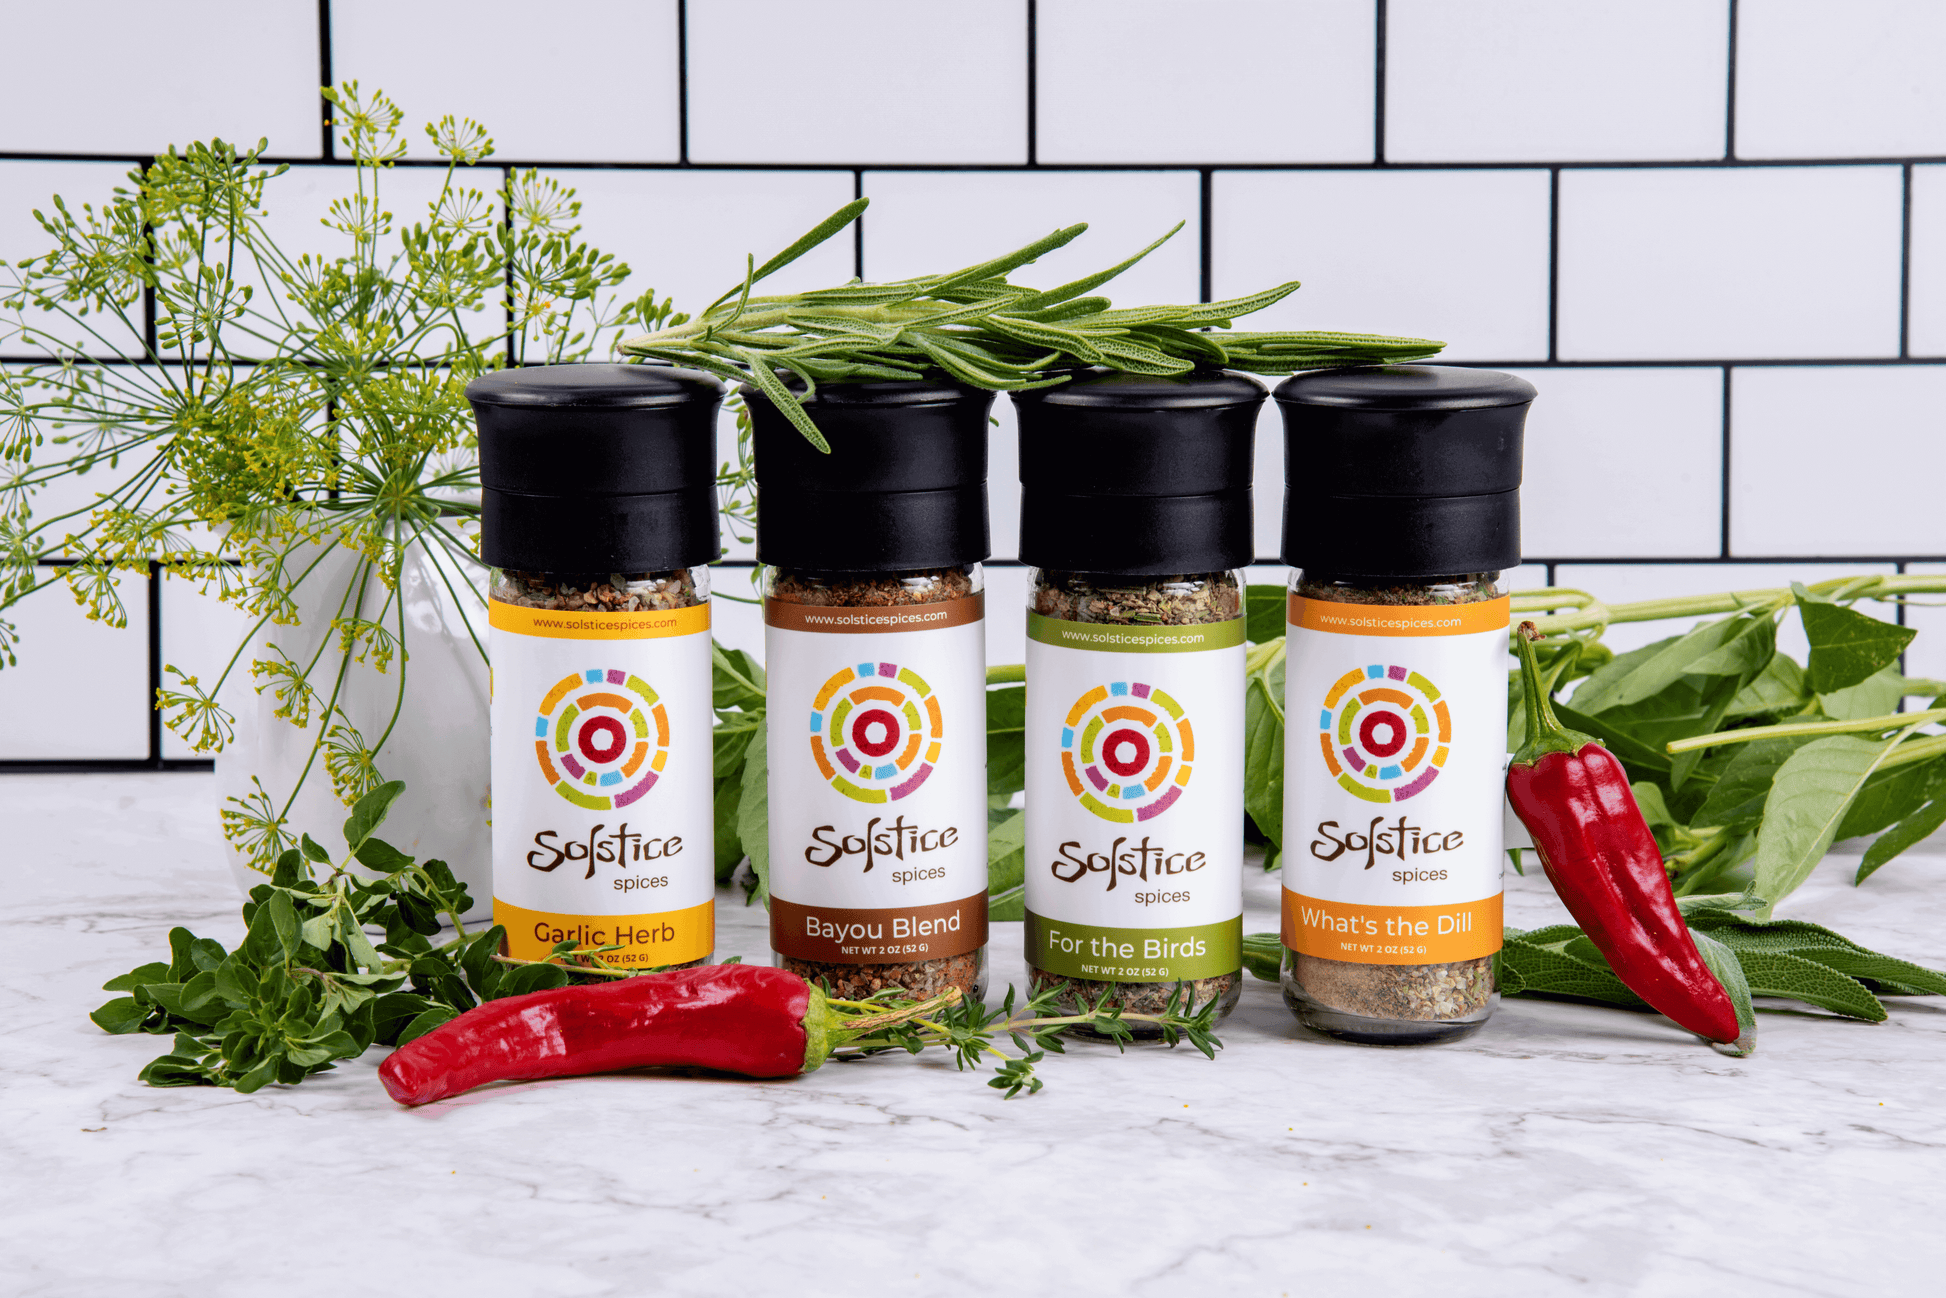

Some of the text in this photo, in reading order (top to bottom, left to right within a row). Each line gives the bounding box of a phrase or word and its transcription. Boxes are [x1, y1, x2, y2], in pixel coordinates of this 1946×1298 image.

[533, 617, 677, 632] www.solsticespices.com
[805, 609, 948, 627] www.solsticespices.com
[1320, 614, 1462, 630] www.solsticespices.com
[1062, 628, 1204, 646] www.solsticespices.com
[527, 822, 683, 880] Solstice
[805, 815, 958, 873] Solstice
[1310, 816, 1464, 870] Solstice
[1051, 836, 1206, 891] Solstice
[613, 875, 669, 893] spices
[892, 867, 946, 885] spices
[1392, 868, 1448, 885] spices
[1134, 889, 1190, 906] spices
[806, 909, 960, 943] Bayou Blend
[1301, 905, 1472, 936] What's the Dill
[534, 922, 675, 946] Garlic Herb
[842, 944, 928, 955] NET WT 2 OZ (52 G)
[1050, 930, 1206, 959] For the Birds
[1340, 942, 1427, 954] NET WT 2 OZ (52 G)
[607, 955, 619, 963] OZ
[622, 954, 637, 964] (52
[639, 953, 649, 962] G)
[1081, 965, 1169, 977] NET WT 2 OZ (52 G)
